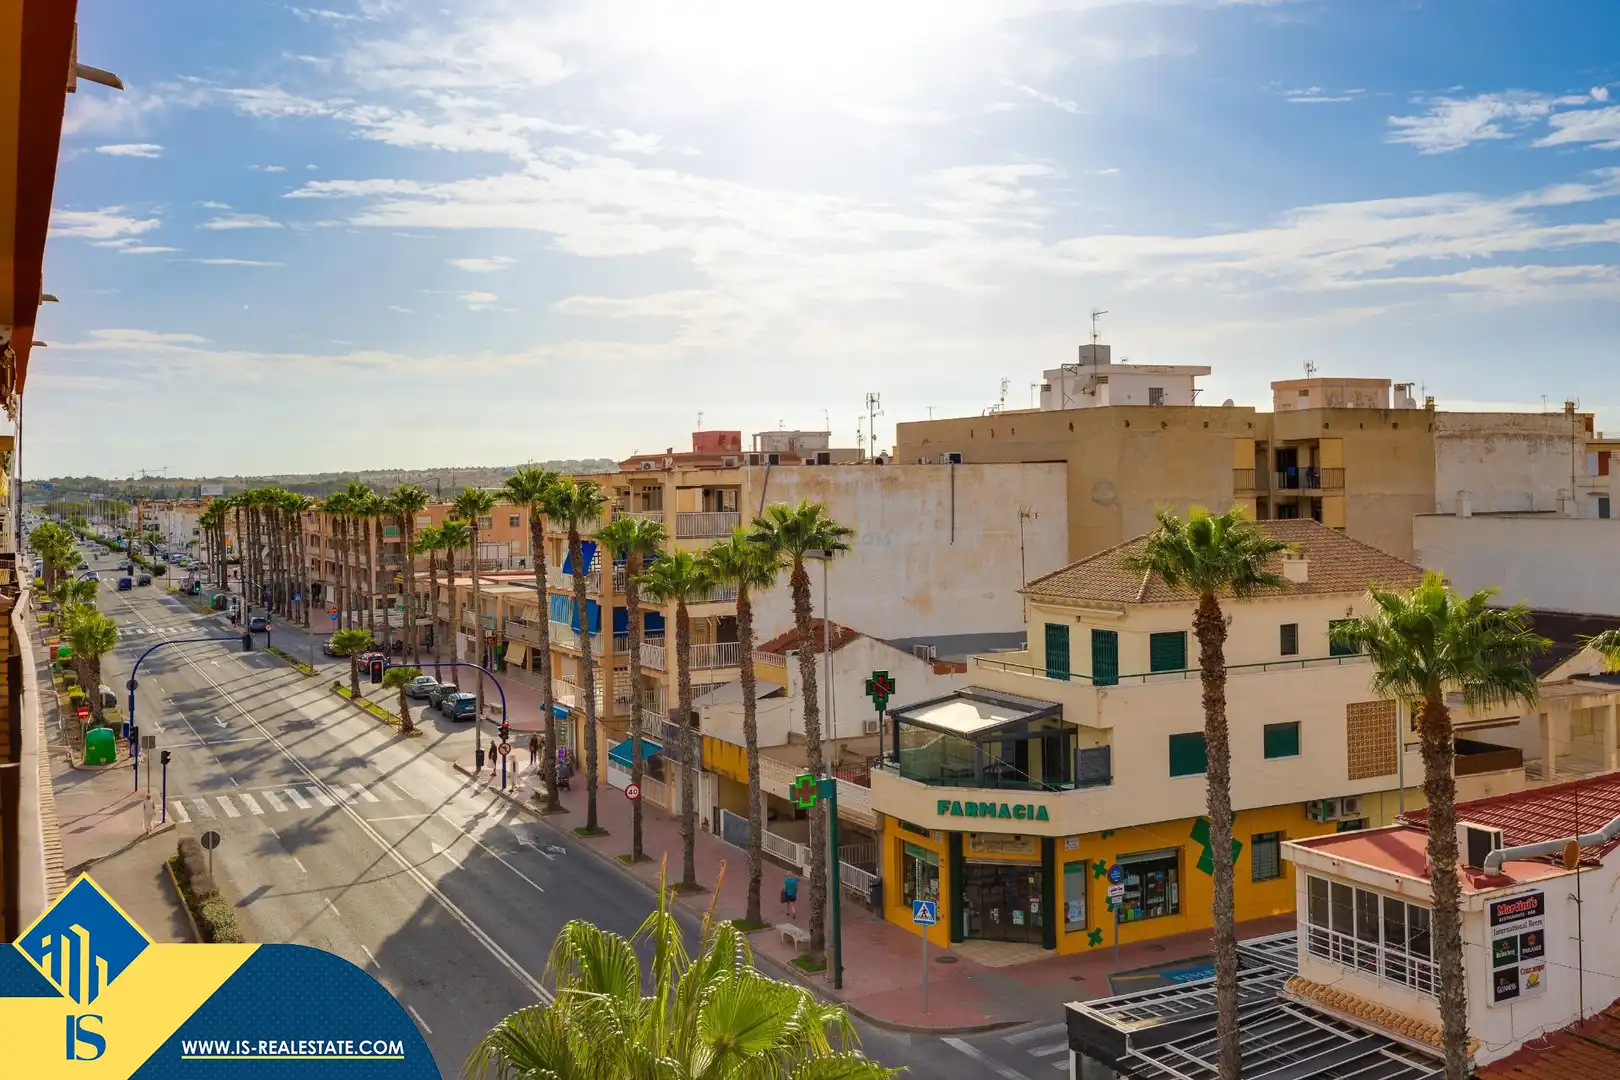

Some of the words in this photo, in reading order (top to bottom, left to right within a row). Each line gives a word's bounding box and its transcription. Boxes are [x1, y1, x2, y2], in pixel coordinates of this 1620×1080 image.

[937, 800, 1050, 821] FARMACIA
[1493, 921, 1528, 936] International
[1528, 919, 1543, 928] Beers
[1496, 983, 1517, 994] GUINNESS
